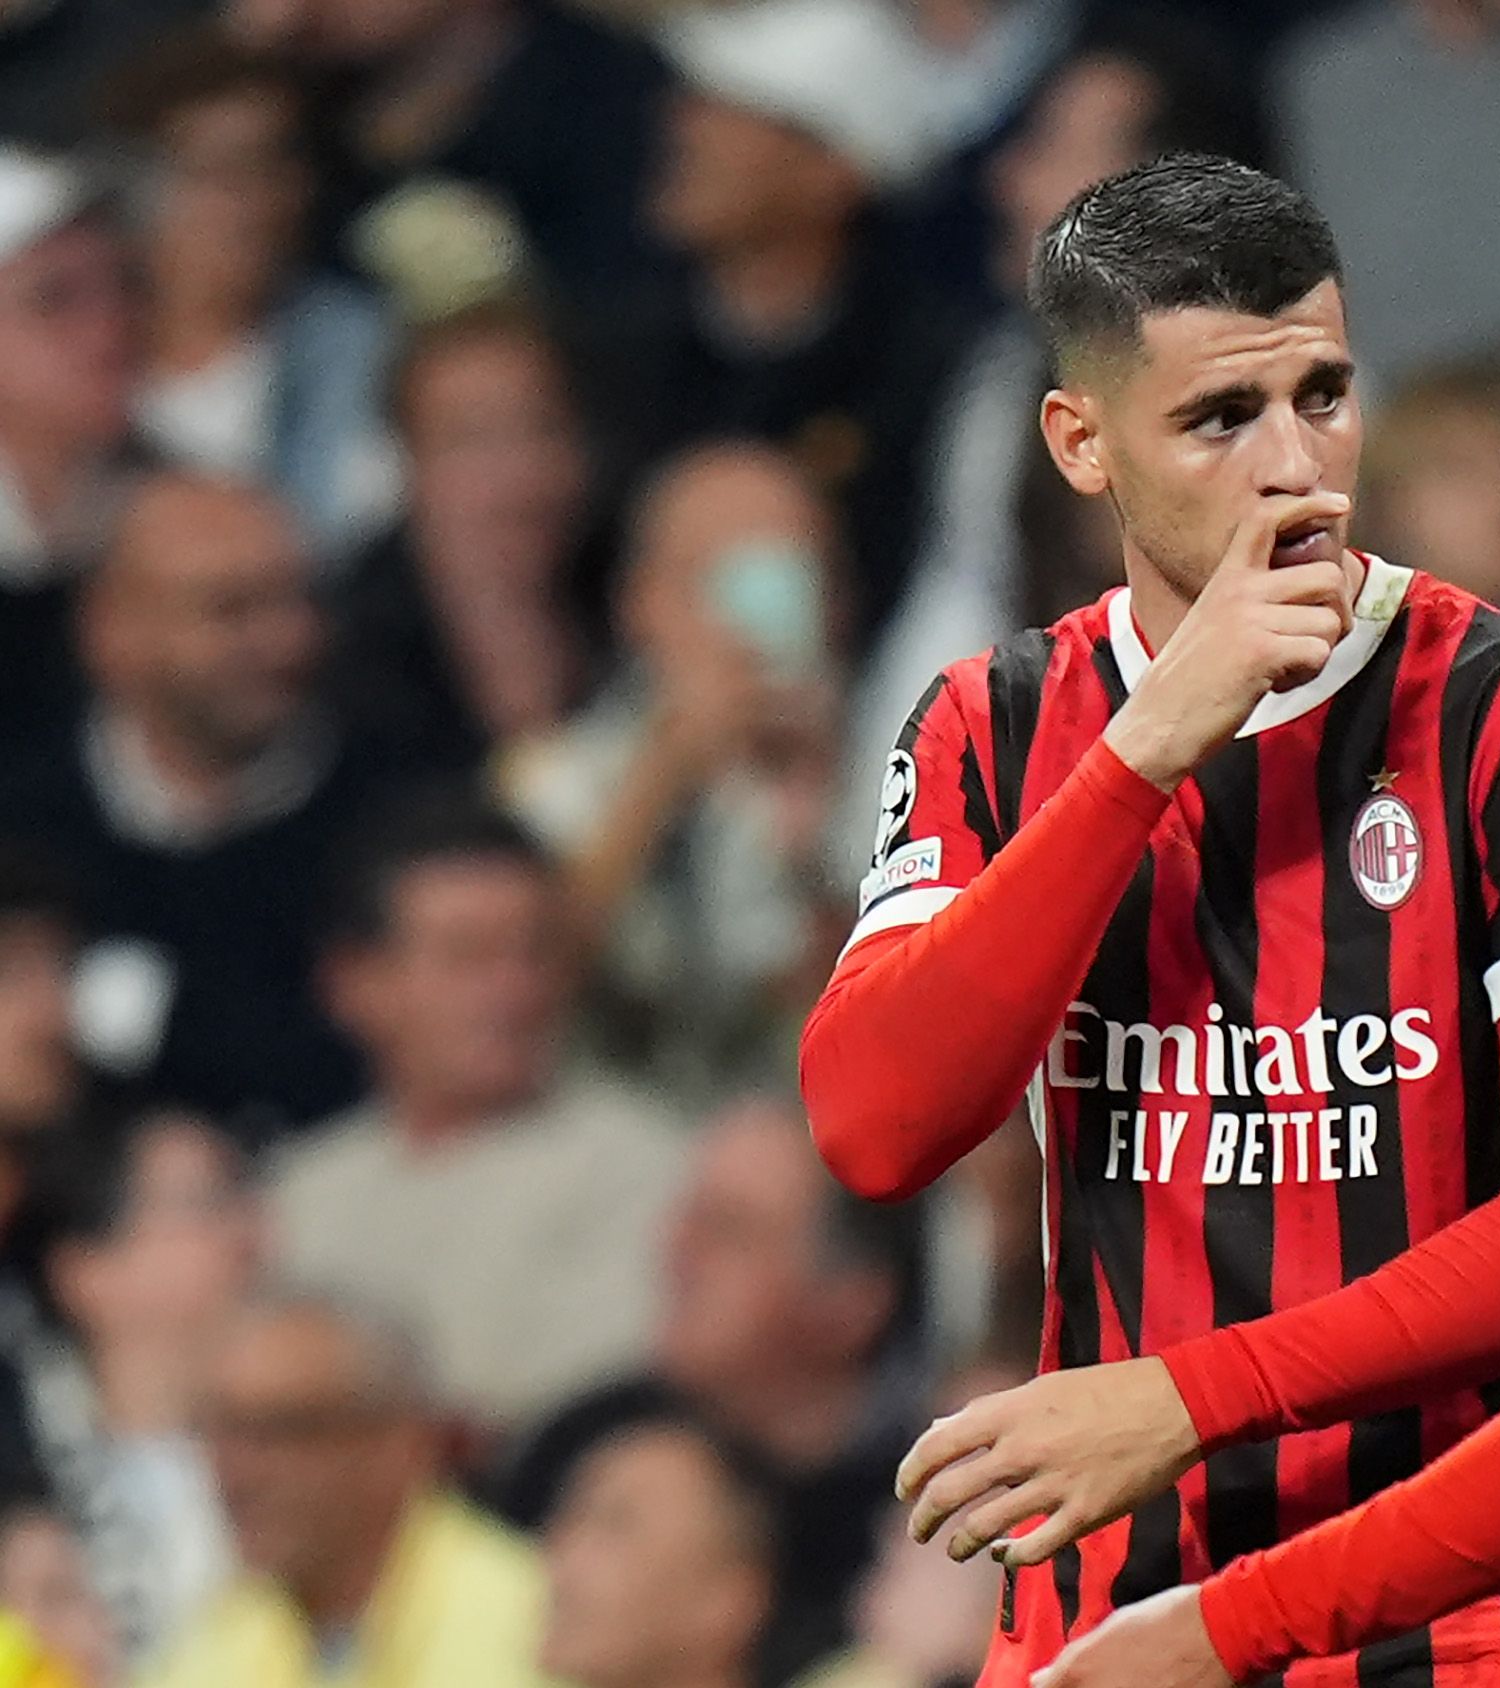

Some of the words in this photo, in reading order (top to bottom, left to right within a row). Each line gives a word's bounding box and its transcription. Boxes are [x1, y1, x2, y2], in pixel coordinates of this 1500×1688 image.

[1366, 803, 1405, 823] ACM
[1373, 882, 1405, 896] 1899
[1047, 1001, 1439, 1096] Emirates
[1105, 1109, 1189, 1183] FLY
[1202, 1104, 1379, 1185] BETTER
